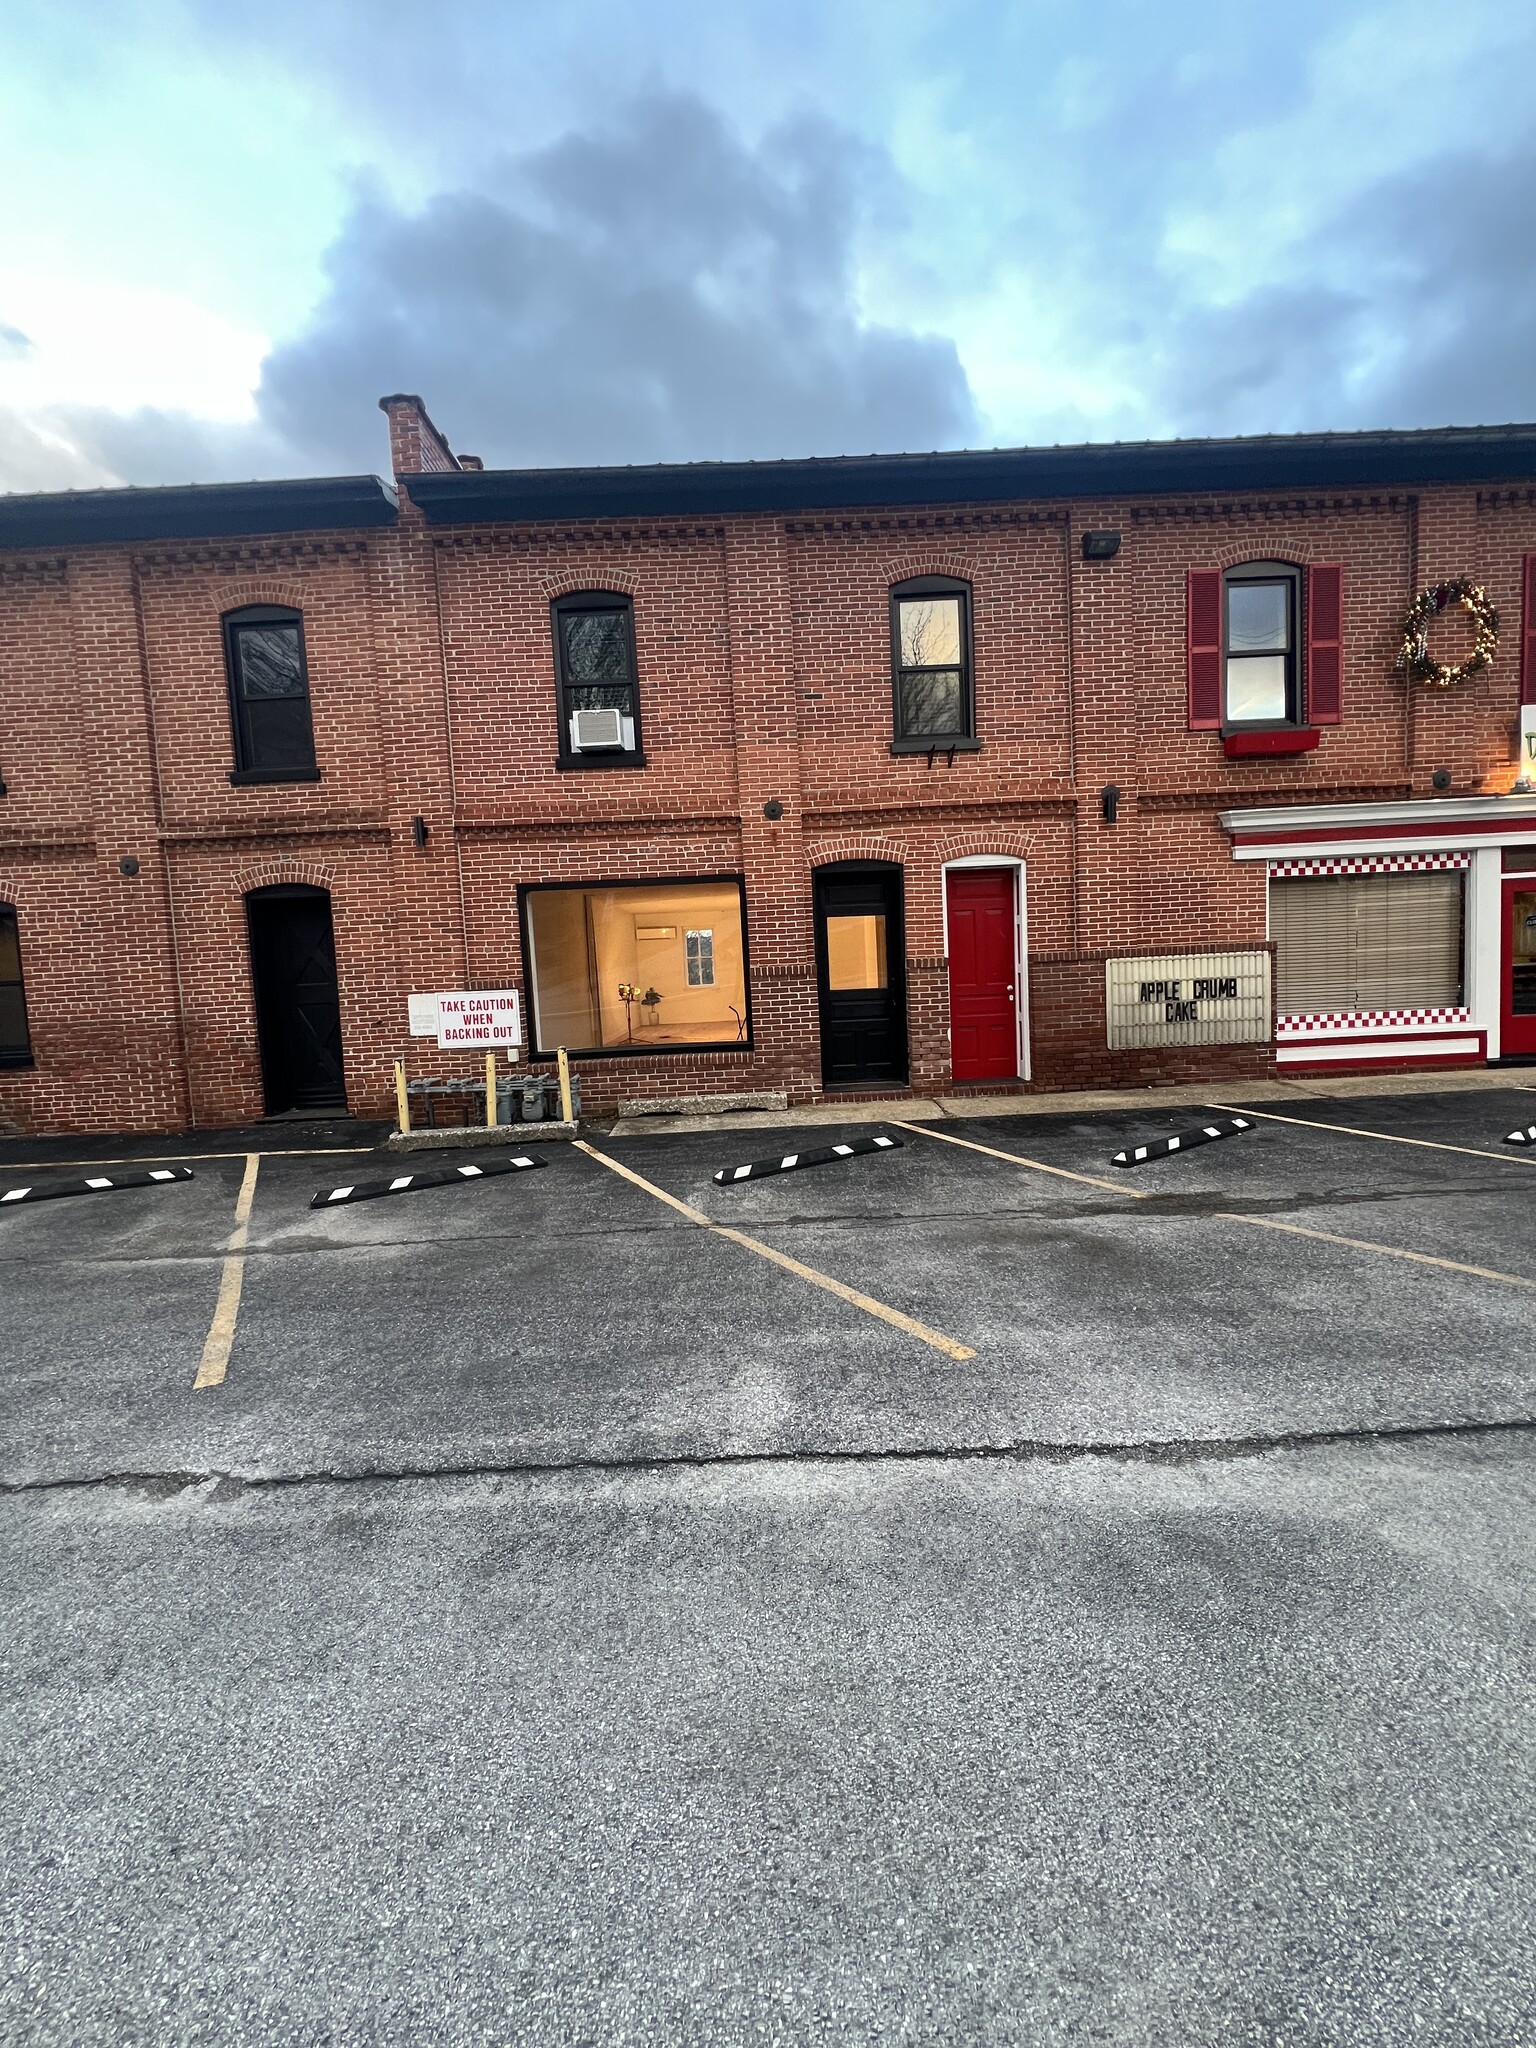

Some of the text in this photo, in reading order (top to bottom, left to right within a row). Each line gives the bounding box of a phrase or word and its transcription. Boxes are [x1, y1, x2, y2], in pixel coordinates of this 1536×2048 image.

[1140, 978, 1237, 1002] APPLE CRUMB
[440, 998, 514, 1012] TAKE CAUTION
[1165, 1001, 1198, 1022] CAKE
[463, 1013, 493, 1025] WHEN
[445, 1026, 513, 1040] BACKING OUT
